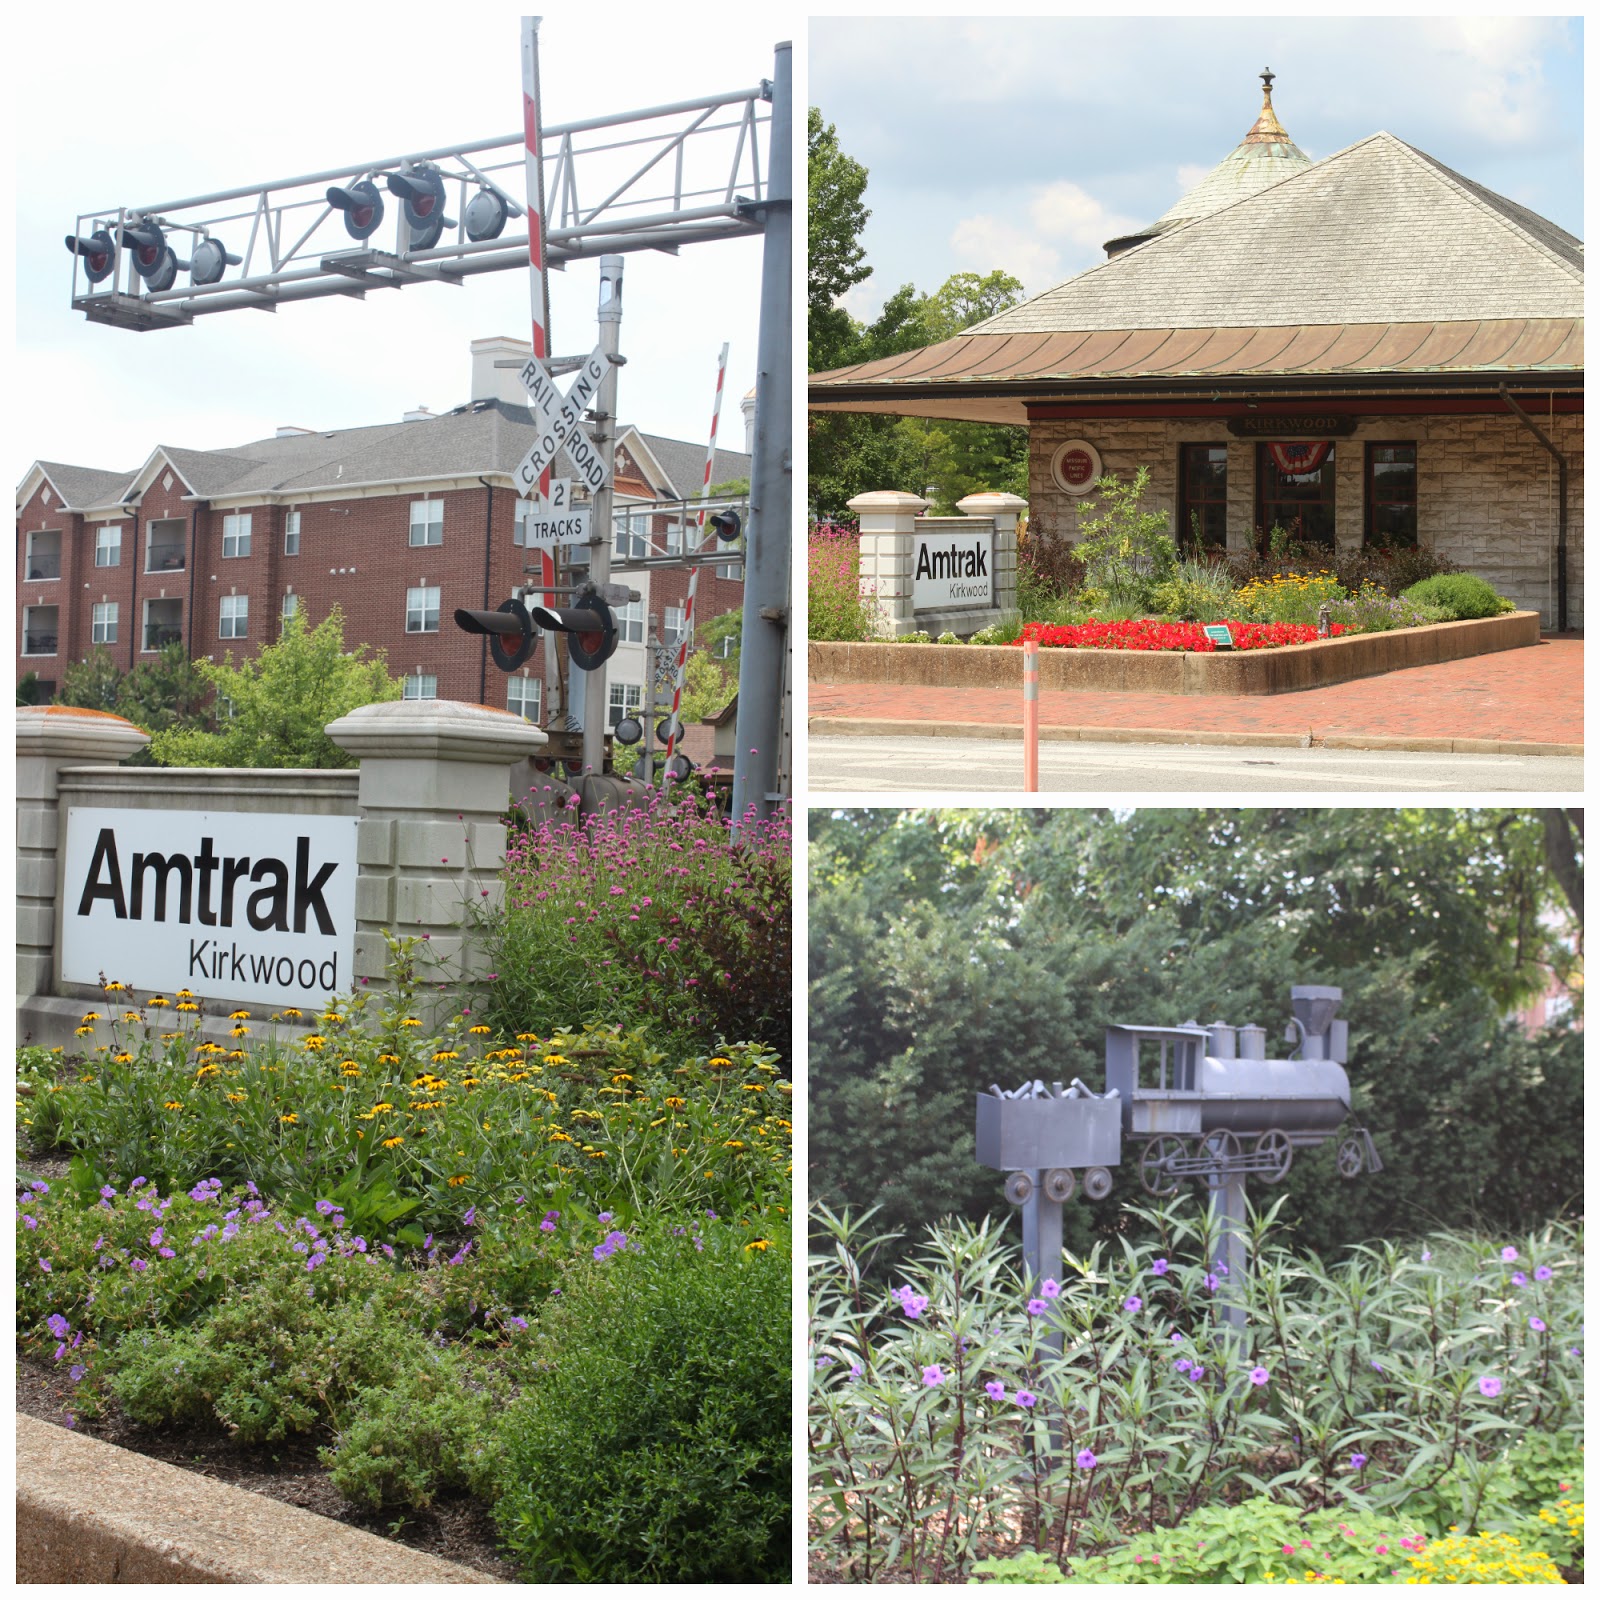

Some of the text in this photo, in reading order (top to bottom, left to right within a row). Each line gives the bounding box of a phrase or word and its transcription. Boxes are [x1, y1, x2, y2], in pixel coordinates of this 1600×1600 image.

[521, 360, 602, 485] CROSSING
[521, 361, 604, 487] RAIL ROAD
[1244, 418, 1337, 429] KIRKWOOD
[553, 483, 564, 507] 2
[534, 518, 582, 539] TRACKS
[915, 541, 988, 580] Amtrak
[949, 582, 988, 599] Kirkwood
[77, 828, 340, 937] Amtrak
[188, 938, 338, 992] Kirkwood
